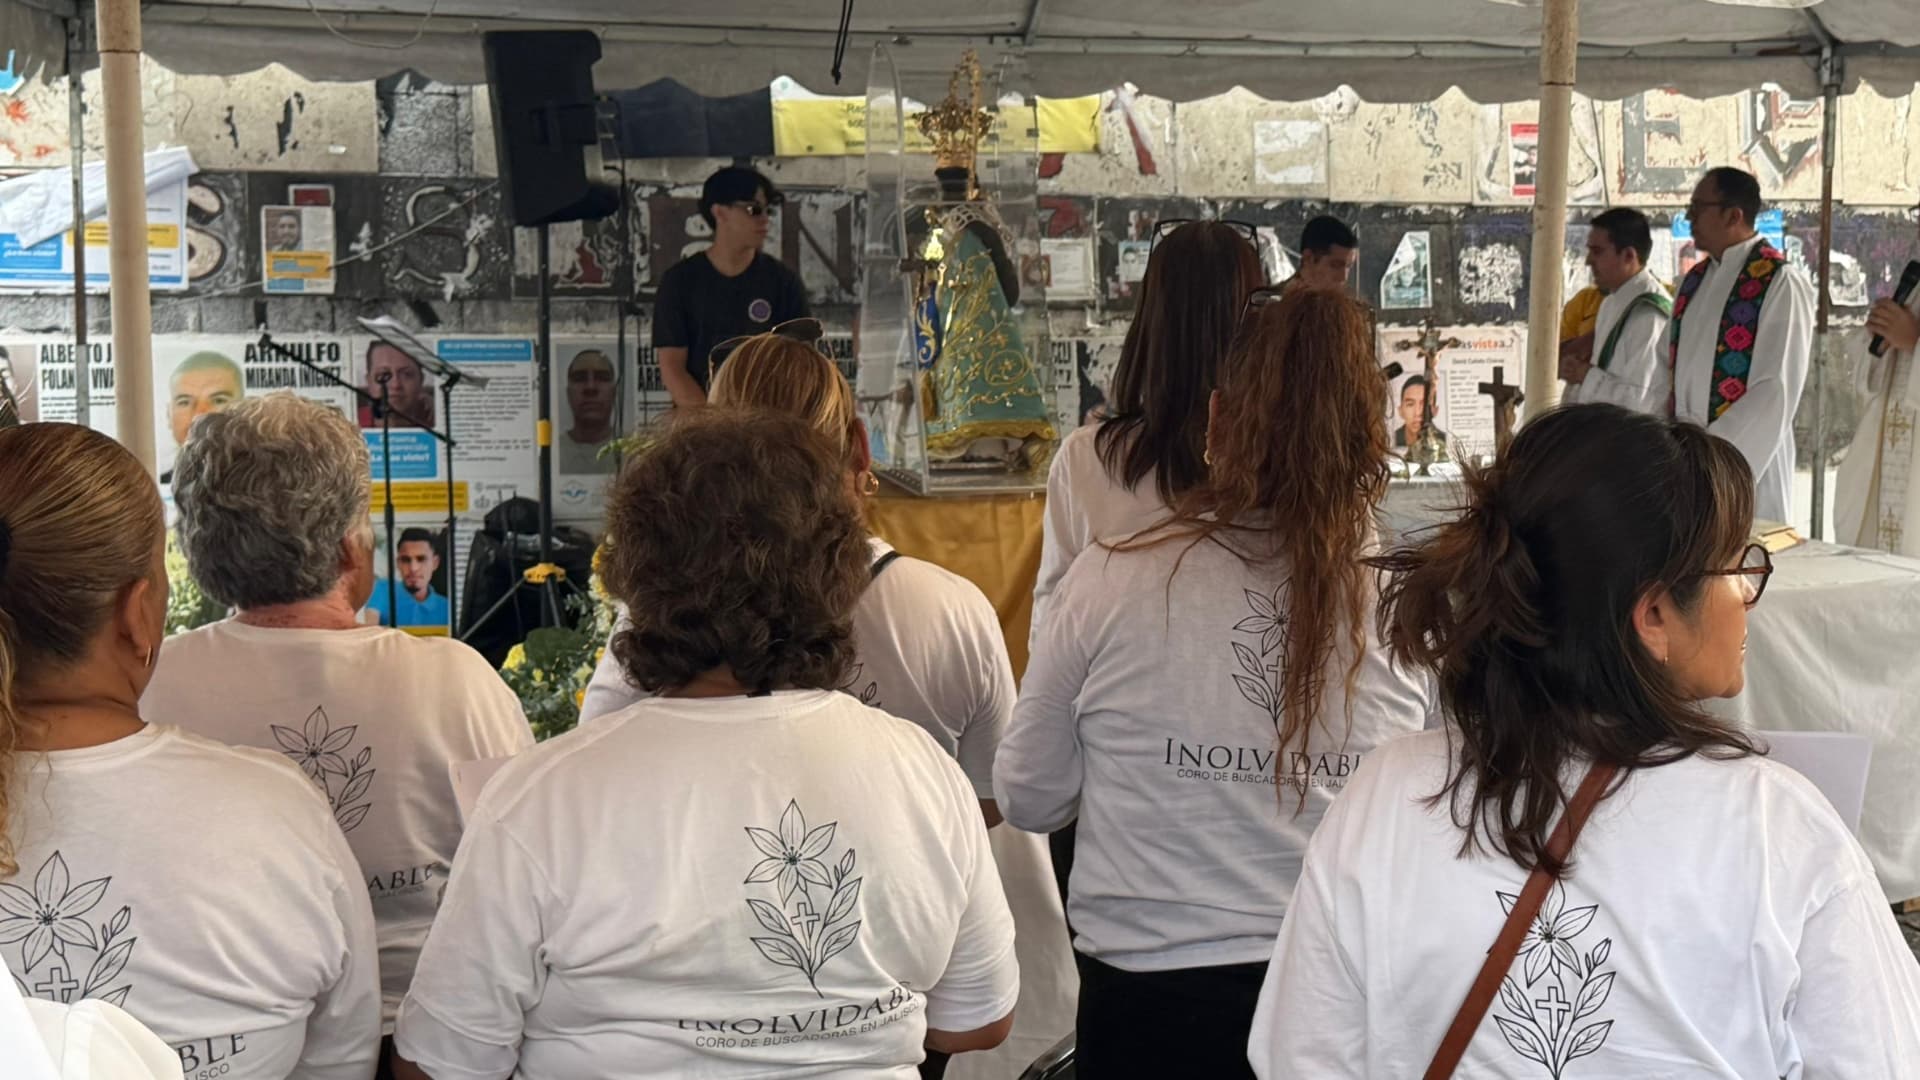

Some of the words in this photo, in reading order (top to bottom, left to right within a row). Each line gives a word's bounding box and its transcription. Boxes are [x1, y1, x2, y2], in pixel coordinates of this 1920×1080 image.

[40, 343, 102, 364] ALBETO
[1177, 768, 1210, 781] CORO
[1213, 771, 1228, 782] DE
[695, 1035, 737, 1049] CORO
[740, 1038, 760, 1048] DE
[860, 1021, 877, 1033] EN
